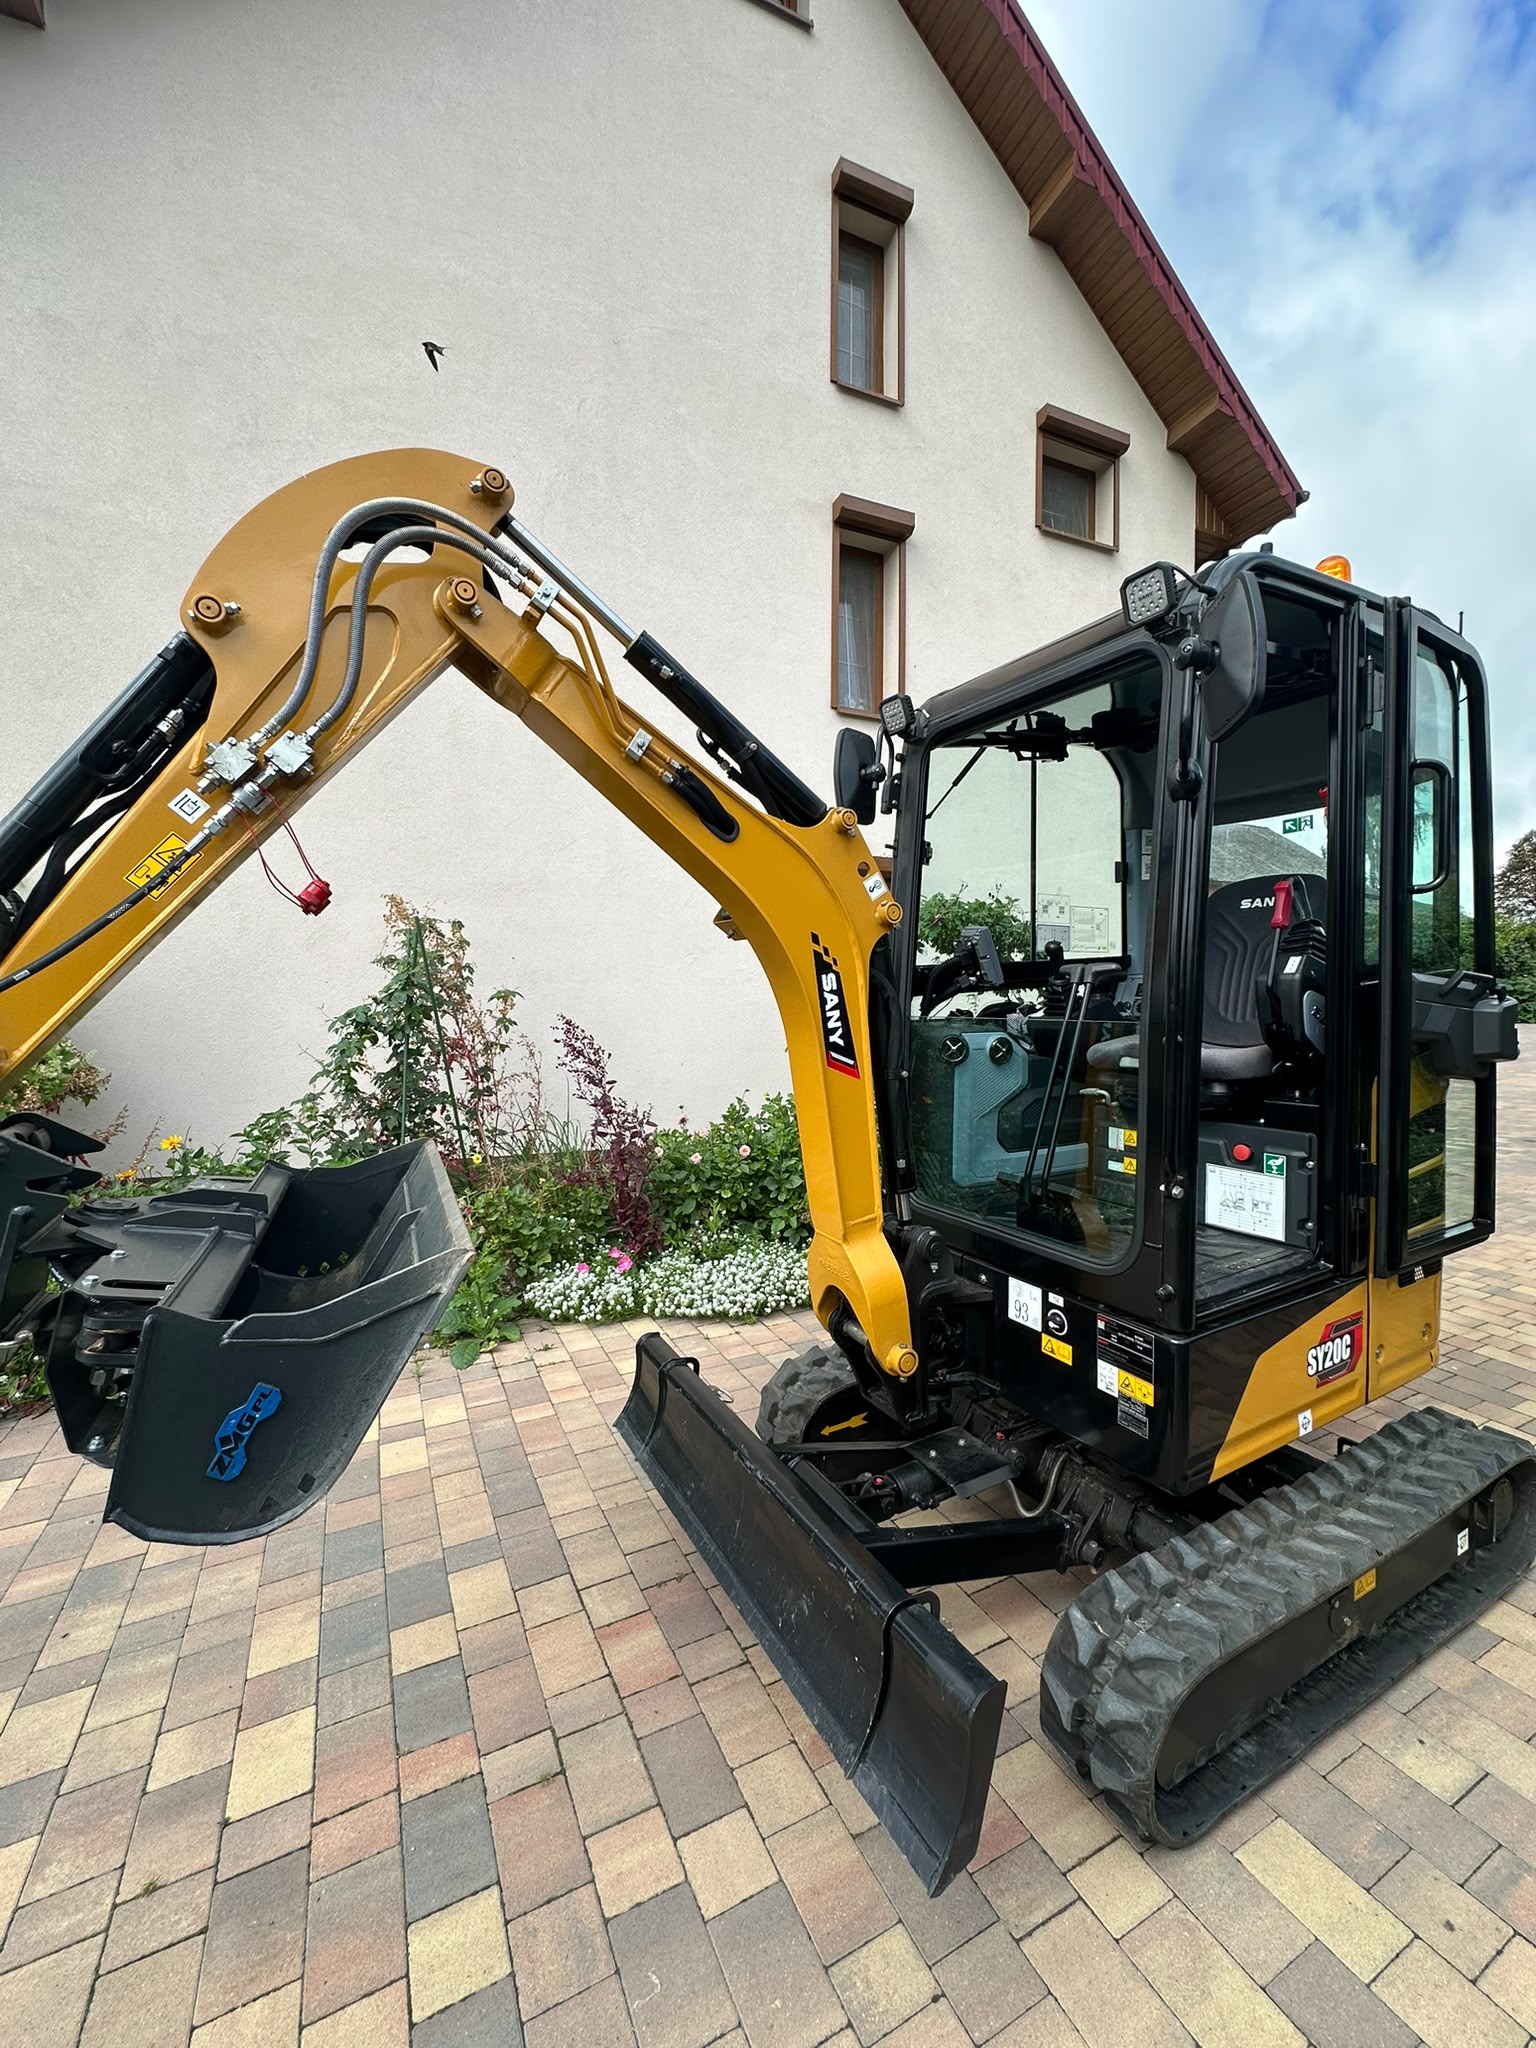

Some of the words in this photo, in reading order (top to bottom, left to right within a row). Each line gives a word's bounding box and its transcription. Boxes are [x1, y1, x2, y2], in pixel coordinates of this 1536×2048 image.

[1240, 897, 1275, 909] SAN
[822, 972, 844, 1047] SANY
[1014, 1299, 1029, 1322] 93
[1307, 1334, 1351, 1376] SY20C
